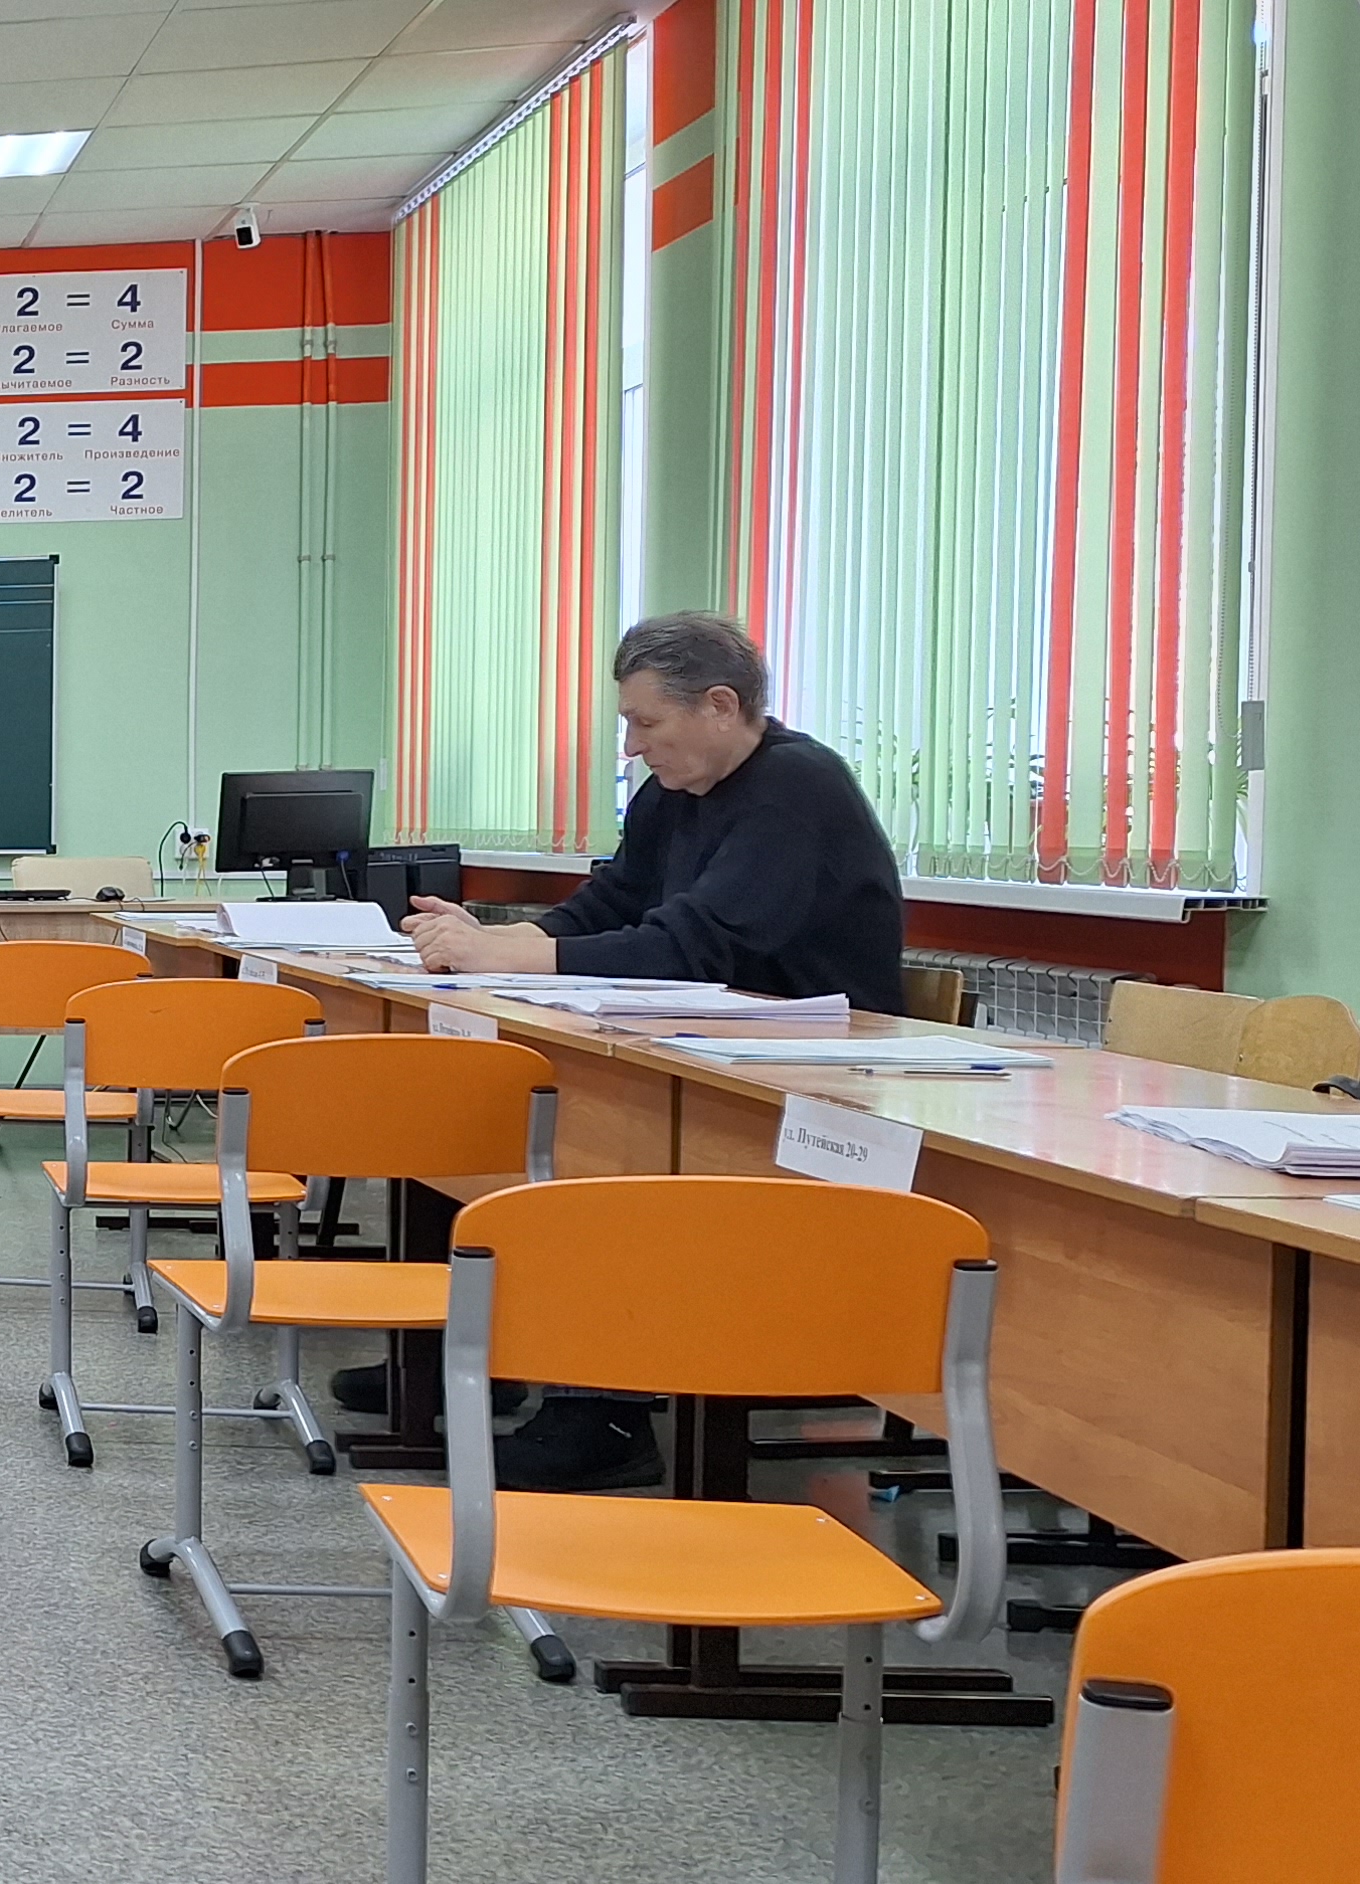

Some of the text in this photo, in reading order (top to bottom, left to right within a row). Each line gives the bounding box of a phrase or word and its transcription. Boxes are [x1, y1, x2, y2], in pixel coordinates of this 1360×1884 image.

[16, 286, 39, 317] 2
[66, 293, 91, 307] =
[117, 284, 141, 313] 4
[110, 319, 155, 332] Сумма
[12, 344, 36, 375] 2
[65, 351, 90, 365] =
[120, 341, 143, 371] 2
[110, 376, 171, 386] Разность
[17, 416, 40, 446] 2
[67, 423, 92, 436] =
[118, 414, 143, 443] 4
[84, 448, 180, 462] Произведение
[13, 473, 36, 503] 2
[66, 480, 91, 493] =
[121, 470, 144, 500] 2
[109, 504, 164, 516] Частное
[797, 1128, 844, 1155] Путейская
[846, 1142, 868, 1162] 20-29
